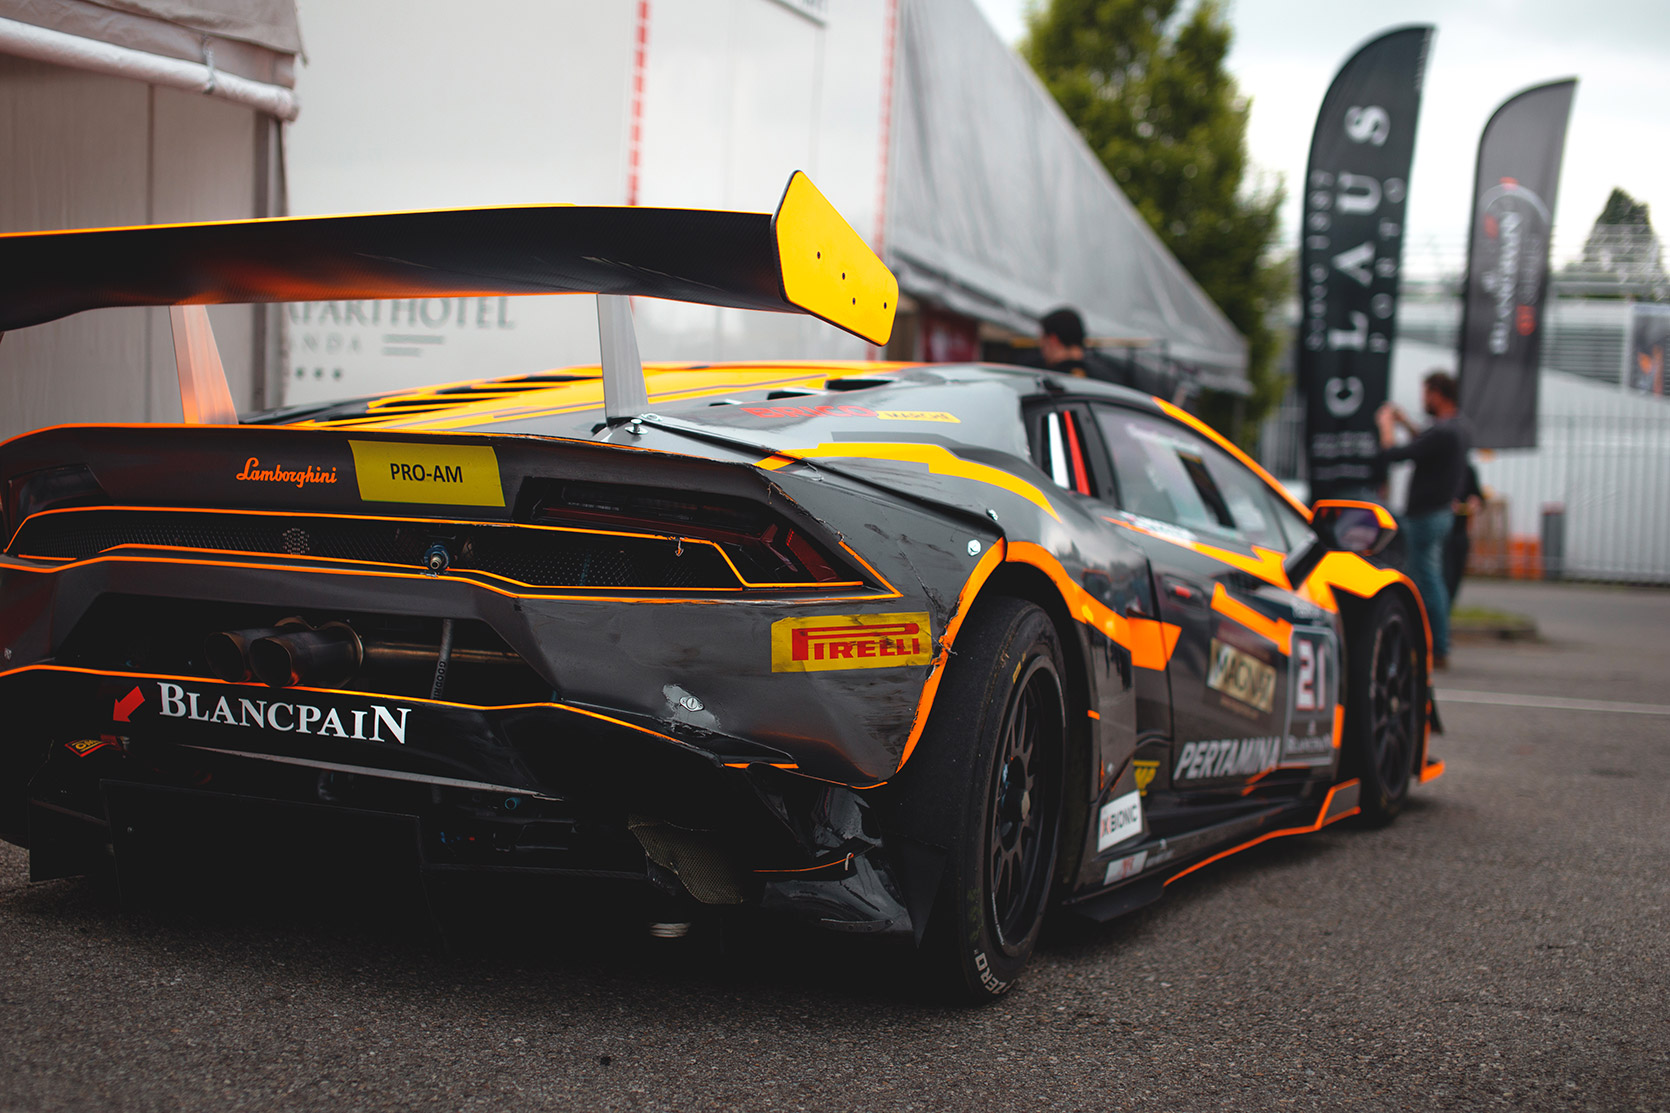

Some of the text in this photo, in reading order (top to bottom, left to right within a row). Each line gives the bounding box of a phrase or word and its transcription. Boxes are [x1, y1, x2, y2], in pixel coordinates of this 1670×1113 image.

[1324, 105, 1391, 417] CLAUS
[740, 405, 878, 418] BRICO
[236, 457, 337, 488] Lamborghini
[390, 463, 463, 483] PRO-AM
[792, 623, 920, 661] PIRELLI
[1296, 639, 1326, 711] 21
[157, 682, 412, 744] BLANCPAIN
[1173, 736, 1281, 780] PERTAMINA
